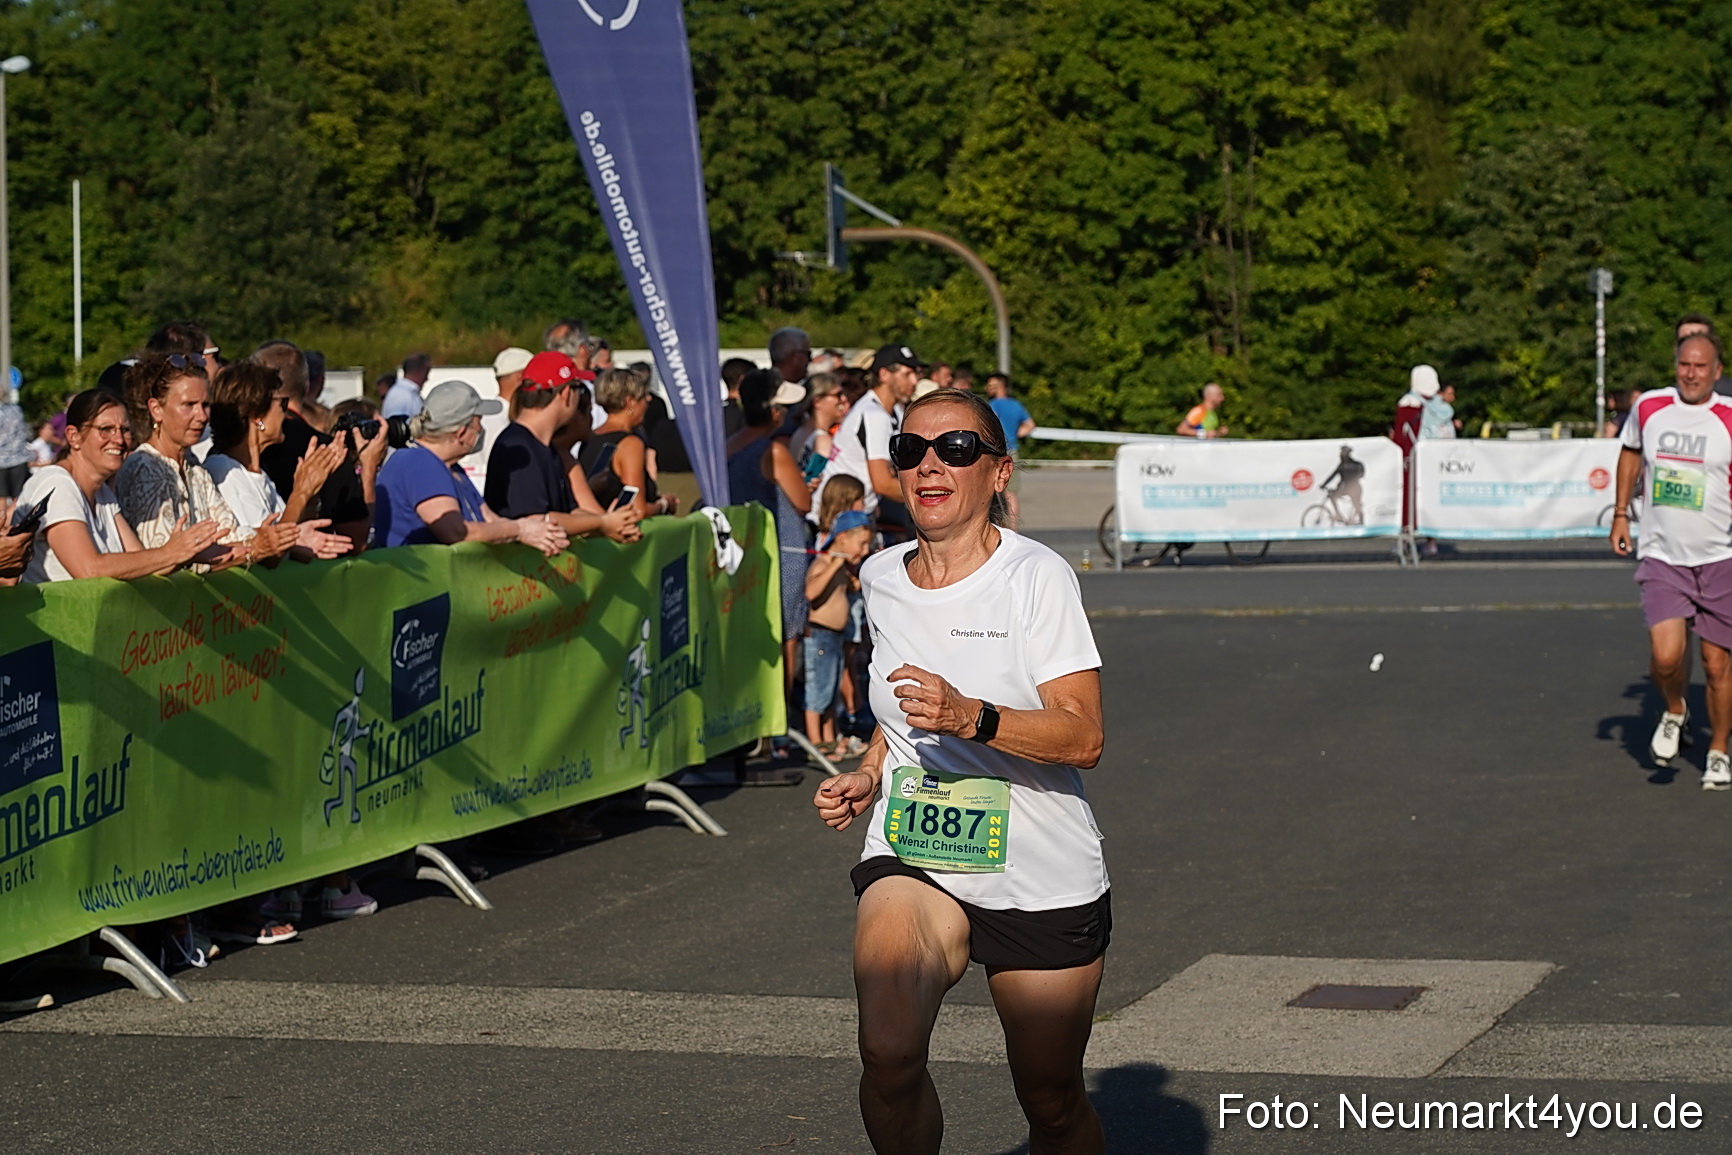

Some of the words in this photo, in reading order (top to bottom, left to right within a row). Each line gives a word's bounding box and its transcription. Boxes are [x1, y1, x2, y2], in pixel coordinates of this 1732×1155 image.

[1140, 464, 1175, 477] NOW
[1440, 462, 1475, 474] NOW
[1665, 481, 1693, 497] 503
[121, 600, 206, 675] Gesunde
[211, 594, 275, 641] Firmen
[950, 628, 985, 638] Christine
[158, 660, 217, 723] laufen
[220, 627, 288, 702] länger!
[367, 667, 486, 784] firmenlauf
[367, 766, 424, 812] neumarkt
[916, 786, 952, 797] Firmenlauf
[889, 808, 902, 843] RUN
[904, 800, 987, 840] 1887
[987, 815, 1002, 859] 2022
[898, 833, 929, 850] Wenzl
[931, 839, 987, 855] Christine
[0, 854, 35, 895] arkt
[78, 826, 286, 913] www.firmenlauf-oberpfalz.de
